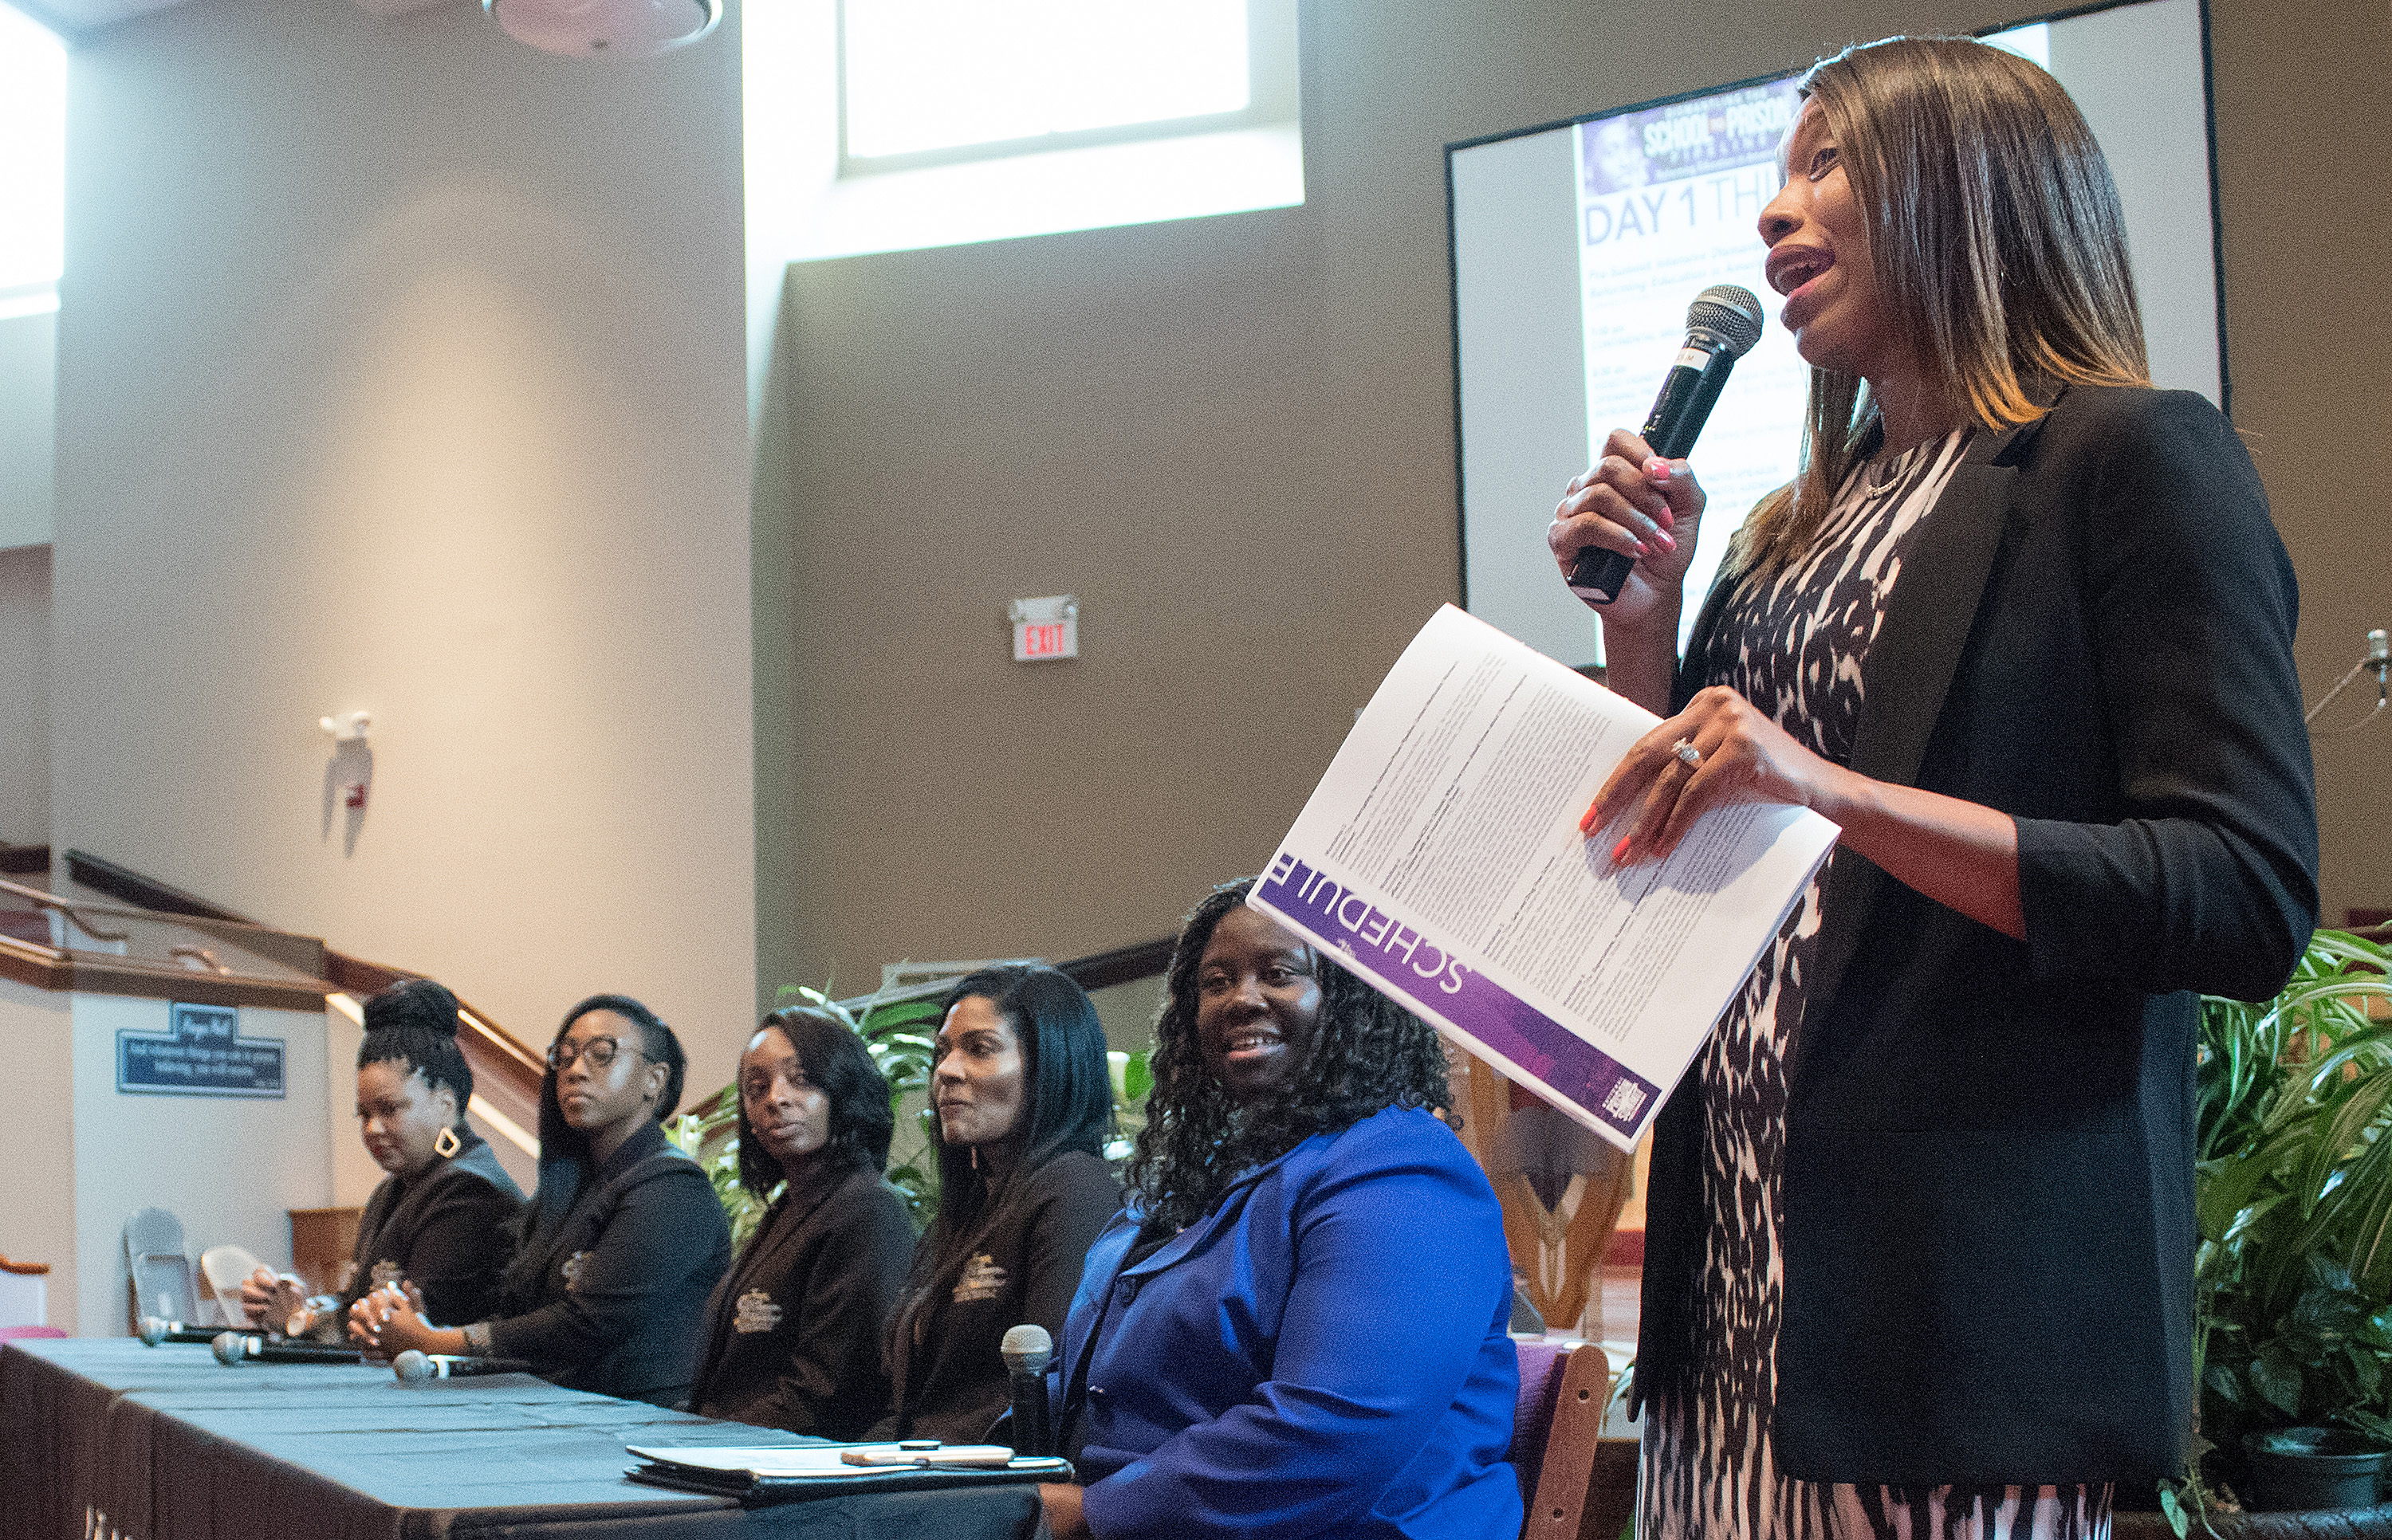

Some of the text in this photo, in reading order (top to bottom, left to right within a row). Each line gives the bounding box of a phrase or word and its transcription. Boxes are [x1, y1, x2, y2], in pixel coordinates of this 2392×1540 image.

[1643, 96, 1794, 159] SCHOOL PRISON
[1585, 191, 1666, 246] DAY
[1679, 185, 1696, 226] 1
[1025, 623, 1064, 655] EXIT
[1268, 851, 1471, 995] SCHEDULE
